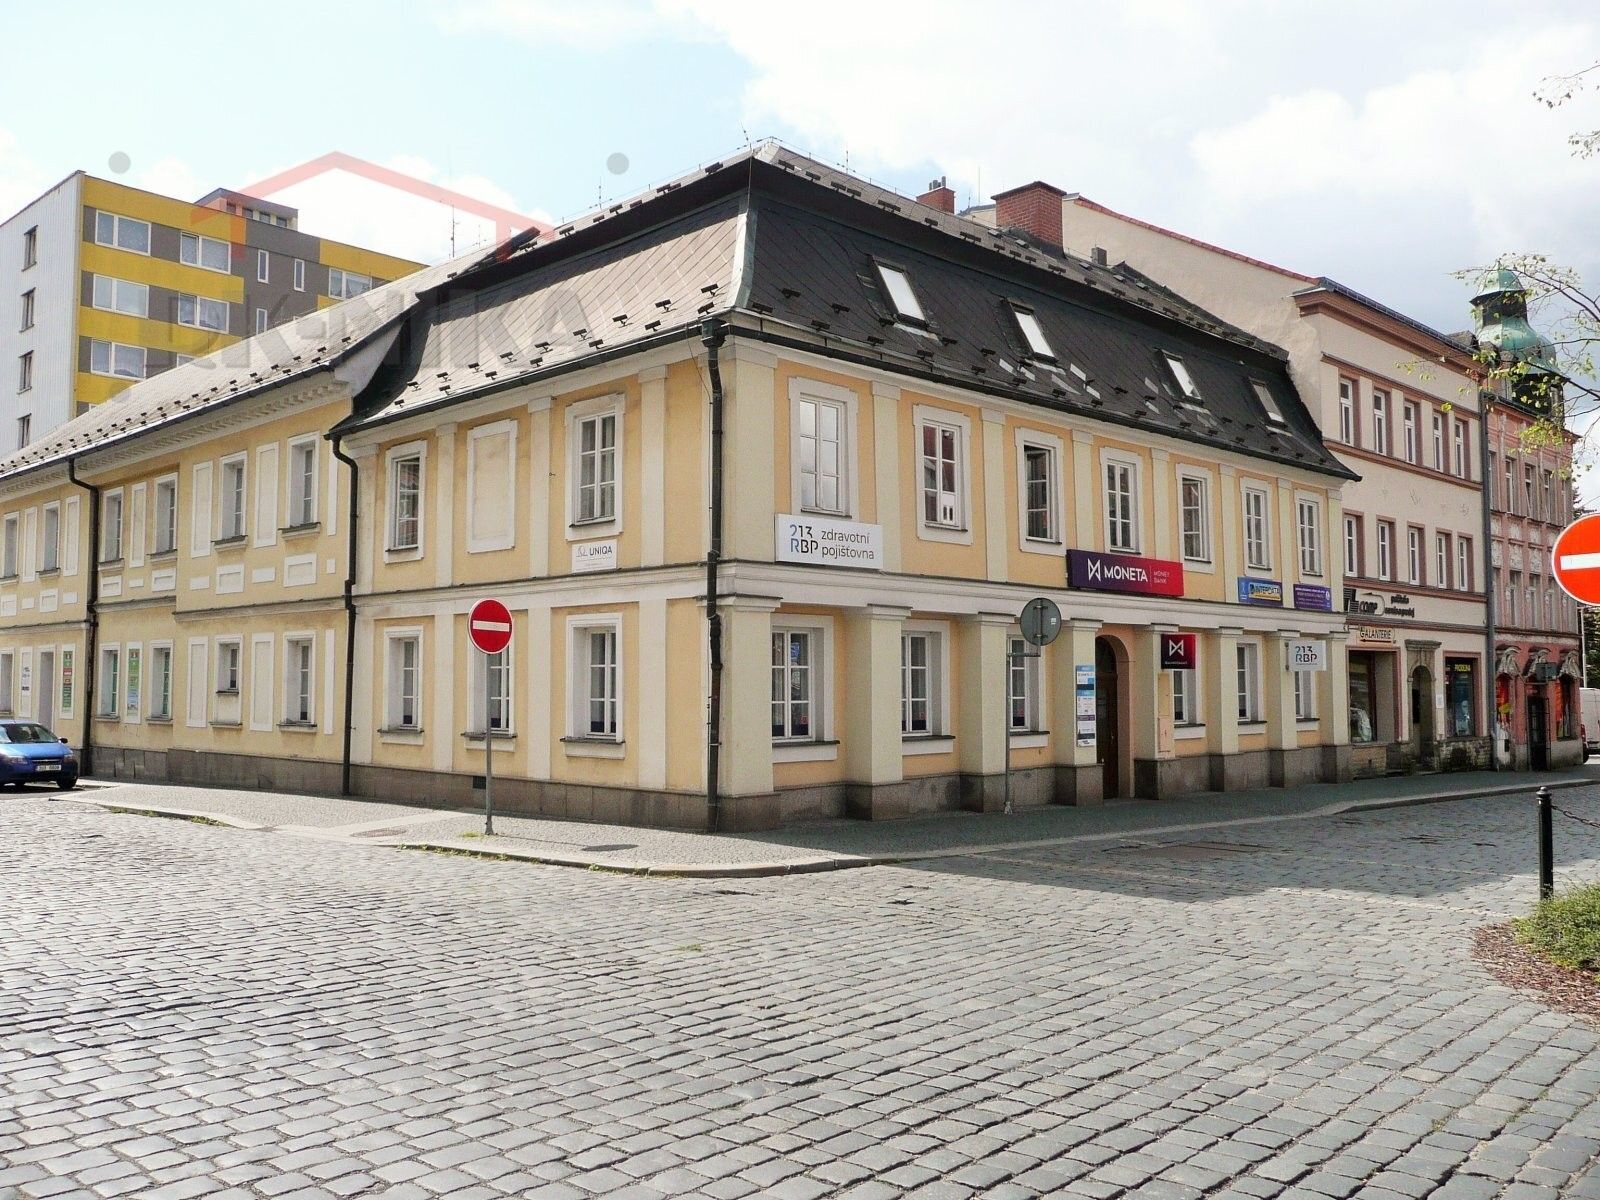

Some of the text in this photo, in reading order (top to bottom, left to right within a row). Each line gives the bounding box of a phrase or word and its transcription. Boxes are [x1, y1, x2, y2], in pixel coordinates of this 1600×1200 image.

[789, 524, 813, 539] 213
[821, 529, 870, 544] zdravotní
[589, 545, 613, 556] UNIQA
[790, 538, 819, 554] RBP
[821, 545, 875, 560] pojišťovna
[1103, 565, 1148, 582] MONETA
[1360, 628, 1391, 639] GALANTERIE
[1295, 645, 1313, 653] 213
[1295, 653, 1318, 662] RBP
